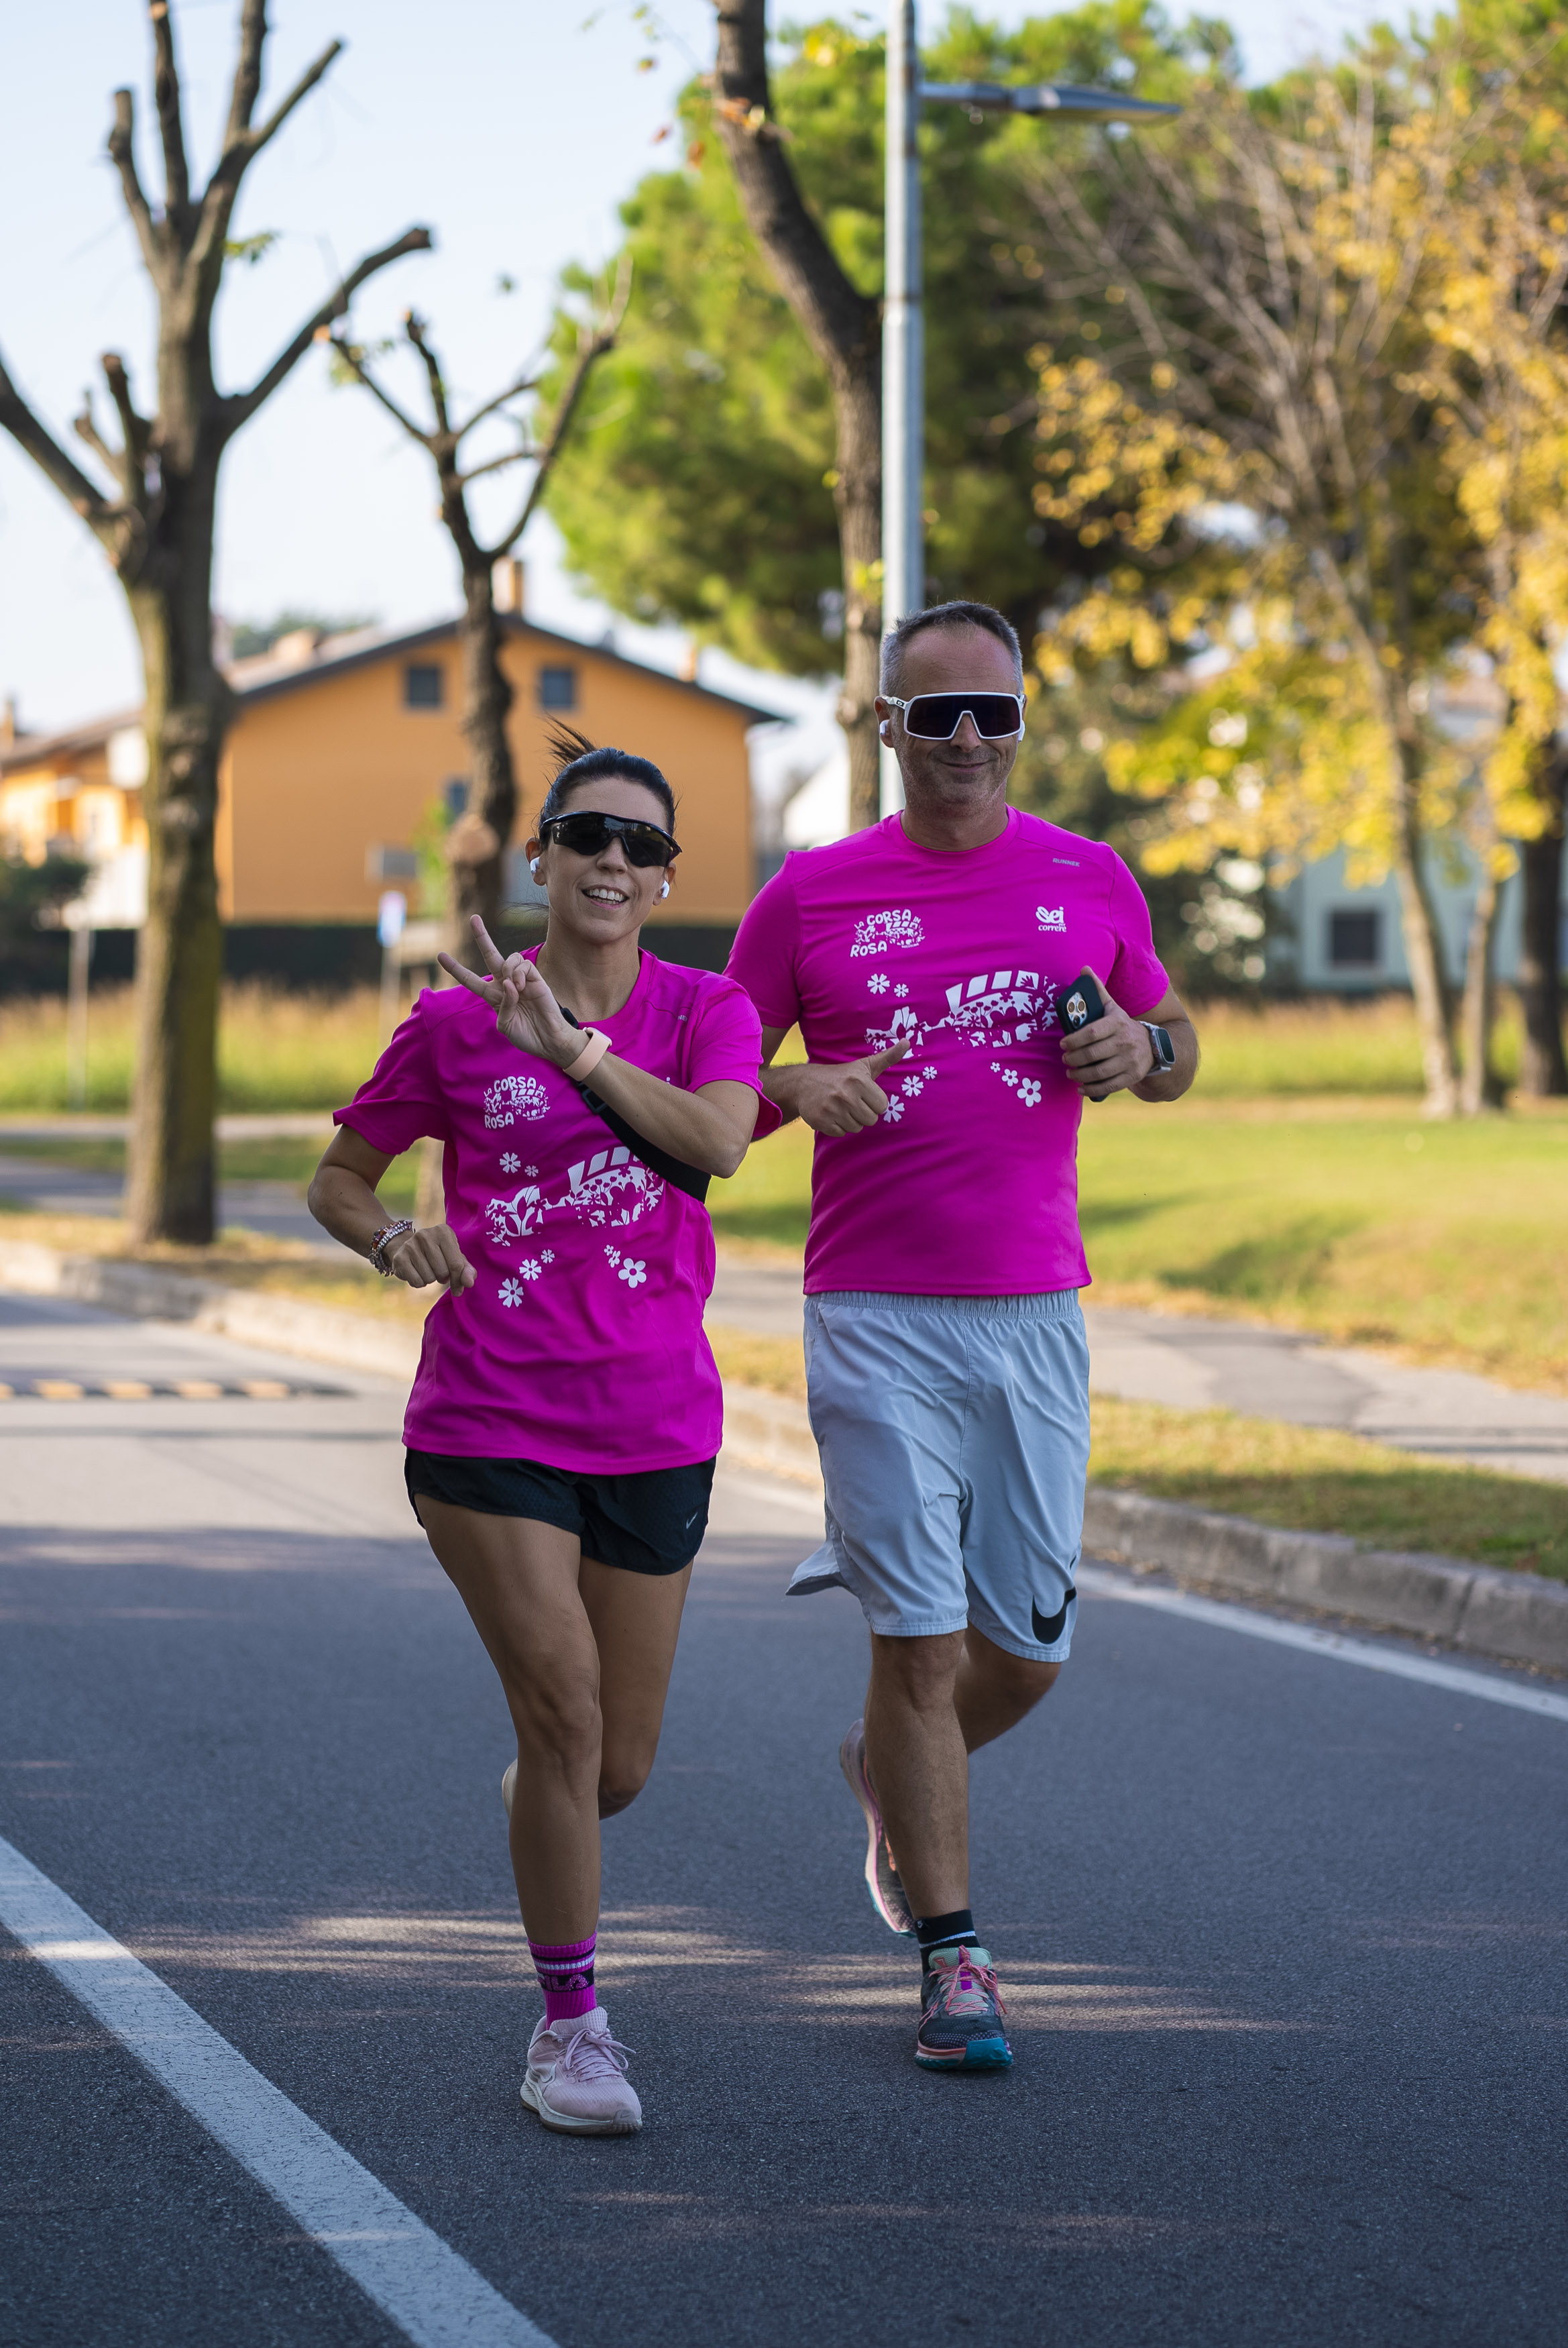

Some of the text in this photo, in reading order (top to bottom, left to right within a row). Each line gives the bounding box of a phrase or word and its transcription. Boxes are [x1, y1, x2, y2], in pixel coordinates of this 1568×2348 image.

[854, 909, 921, 929] LA CORSA IN
[850, 940, 887, 957] ROSA
[484, 1076, 546, 1097] LA CORSA IN
[484, 1112, 514, 1129] ROSA
